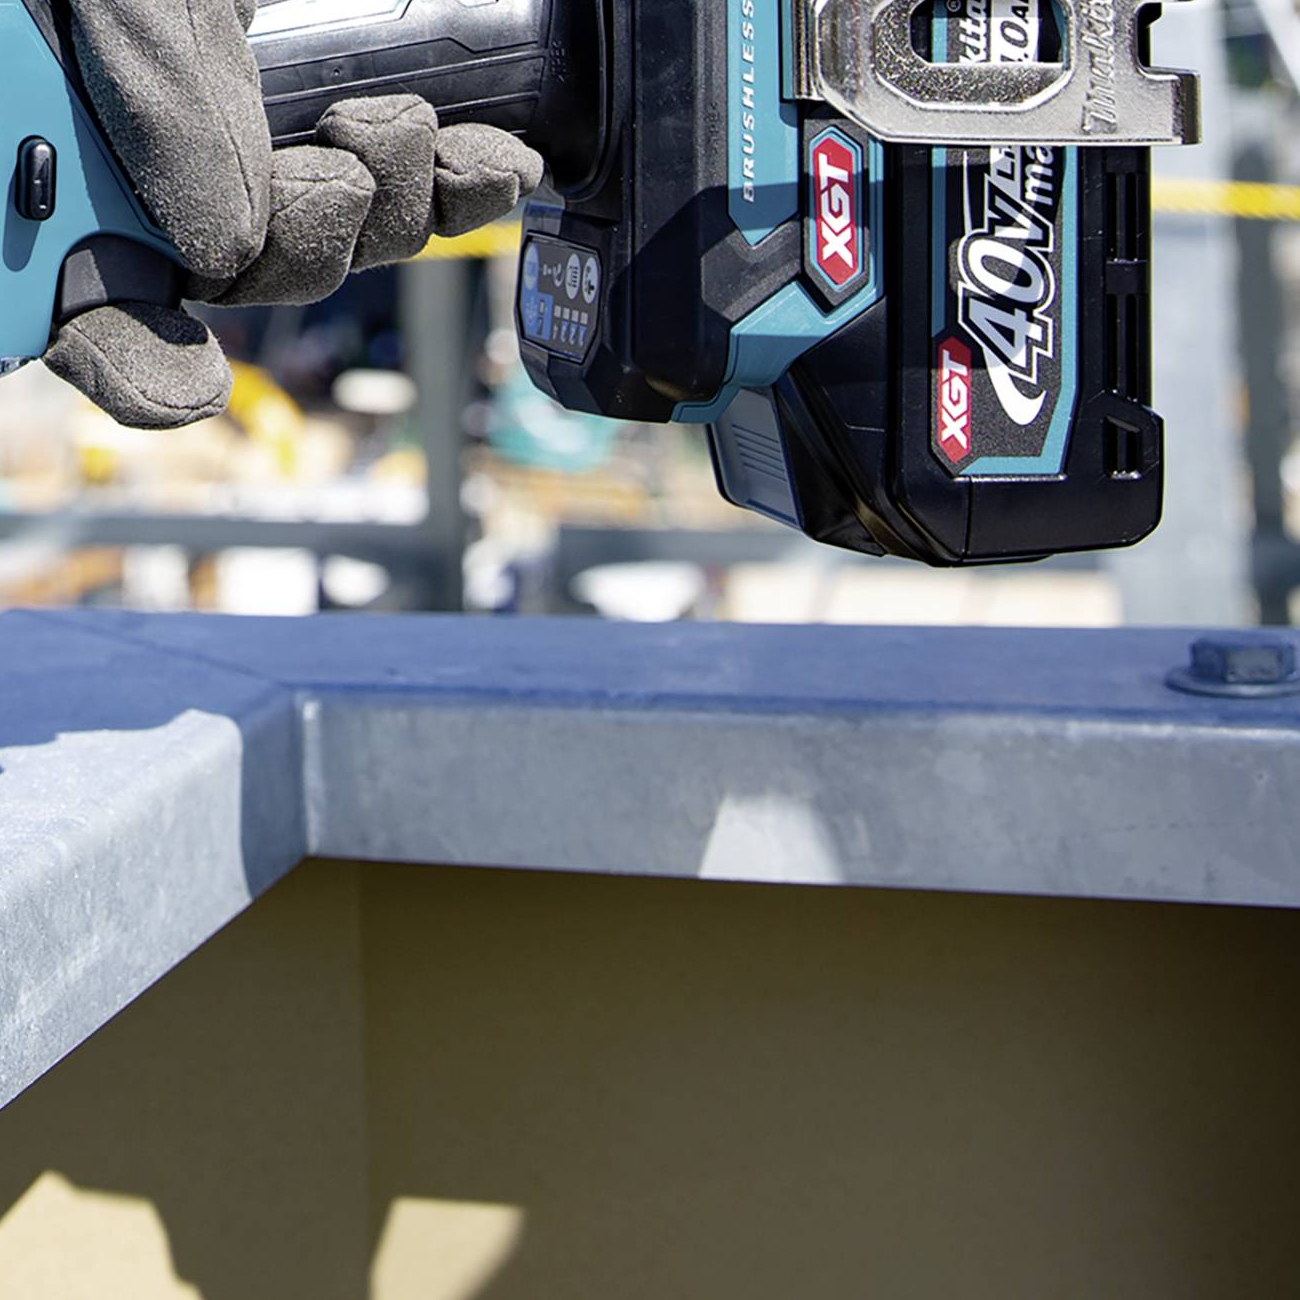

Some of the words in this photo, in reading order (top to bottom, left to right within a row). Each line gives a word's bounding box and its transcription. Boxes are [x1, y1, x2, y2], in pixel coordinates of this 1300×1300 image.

[742, 0, 755, 203] BRUSHLESS
[818, 152, 854, 268] XGT
[1025, 146, 1053, 206] ma
[941, 349, 970, 450] XGT
